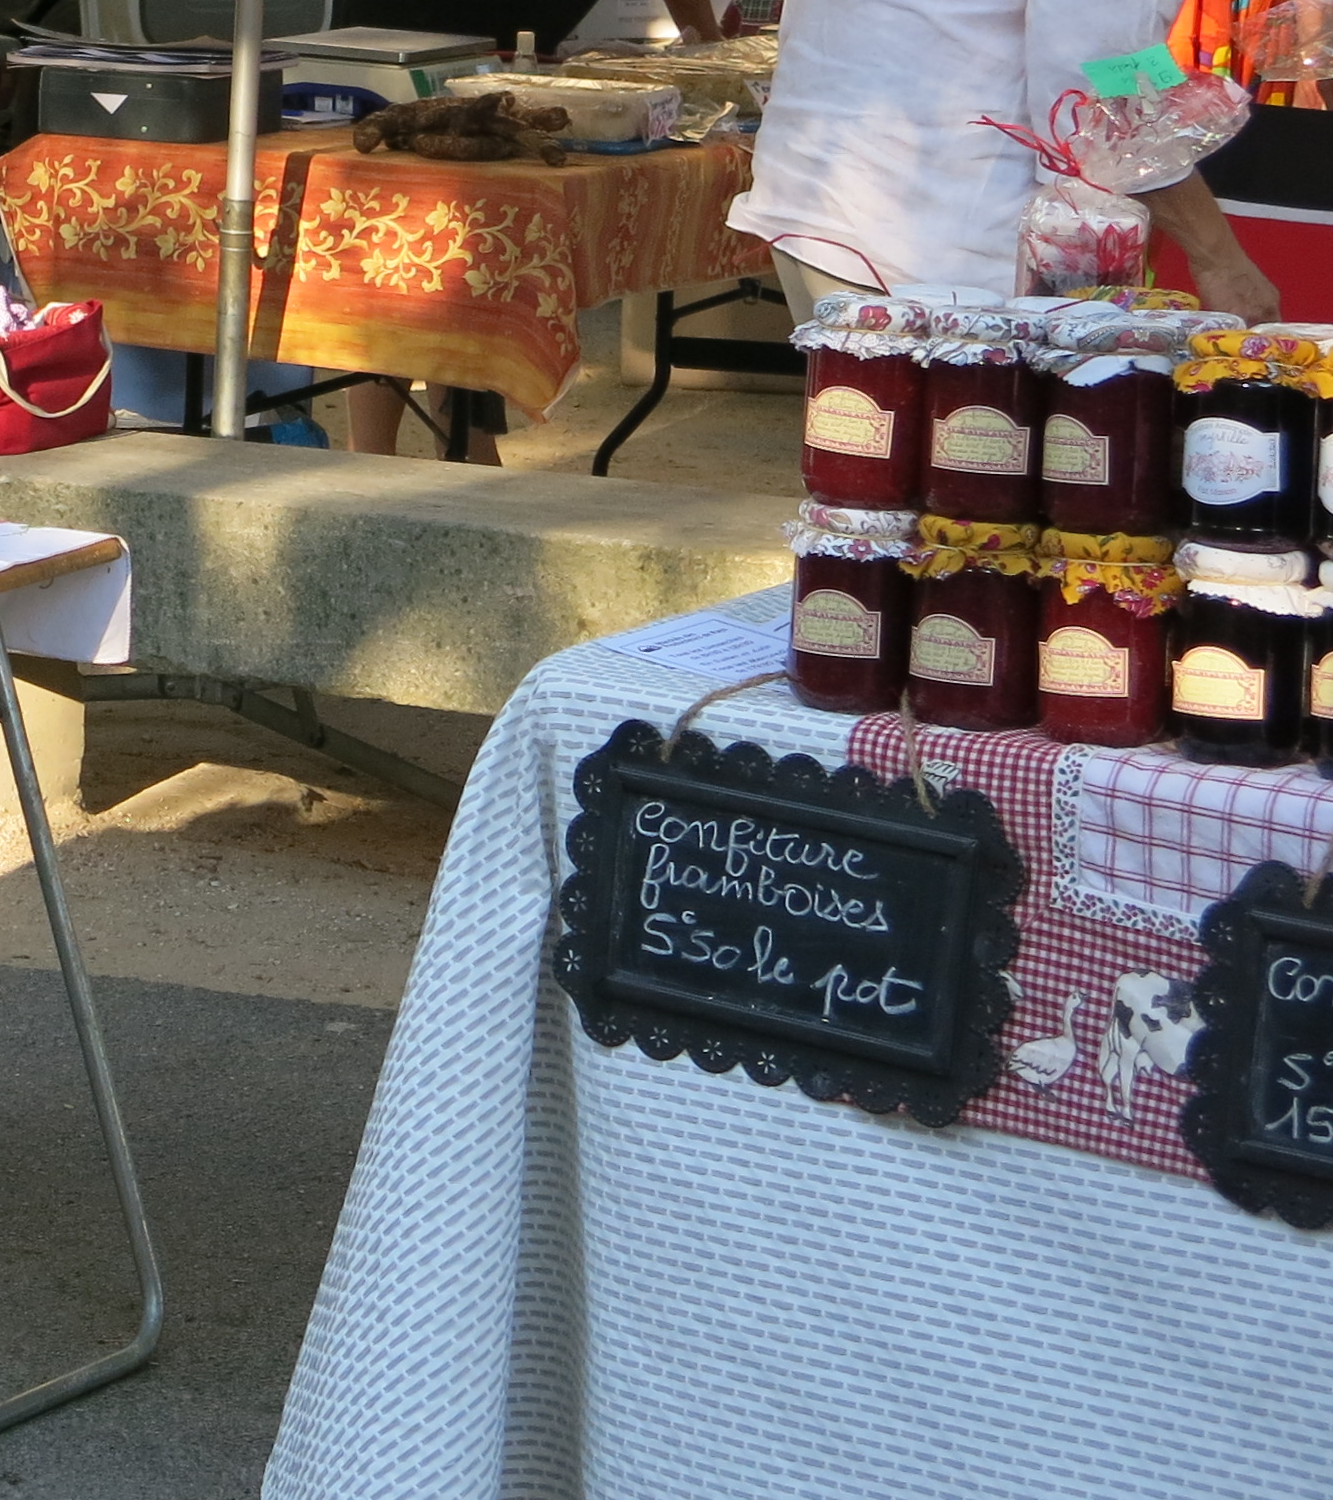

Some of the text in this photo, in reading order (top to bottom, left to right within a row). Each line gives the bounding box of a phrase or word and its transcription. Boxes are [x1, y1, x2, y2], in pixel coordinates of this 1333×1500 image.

[634, 801, 880, 879] Confiture
[639, 841, 890, 933] framboises
[746, 924, 795, 984] le
[809, 963, 925, 1018] pot
